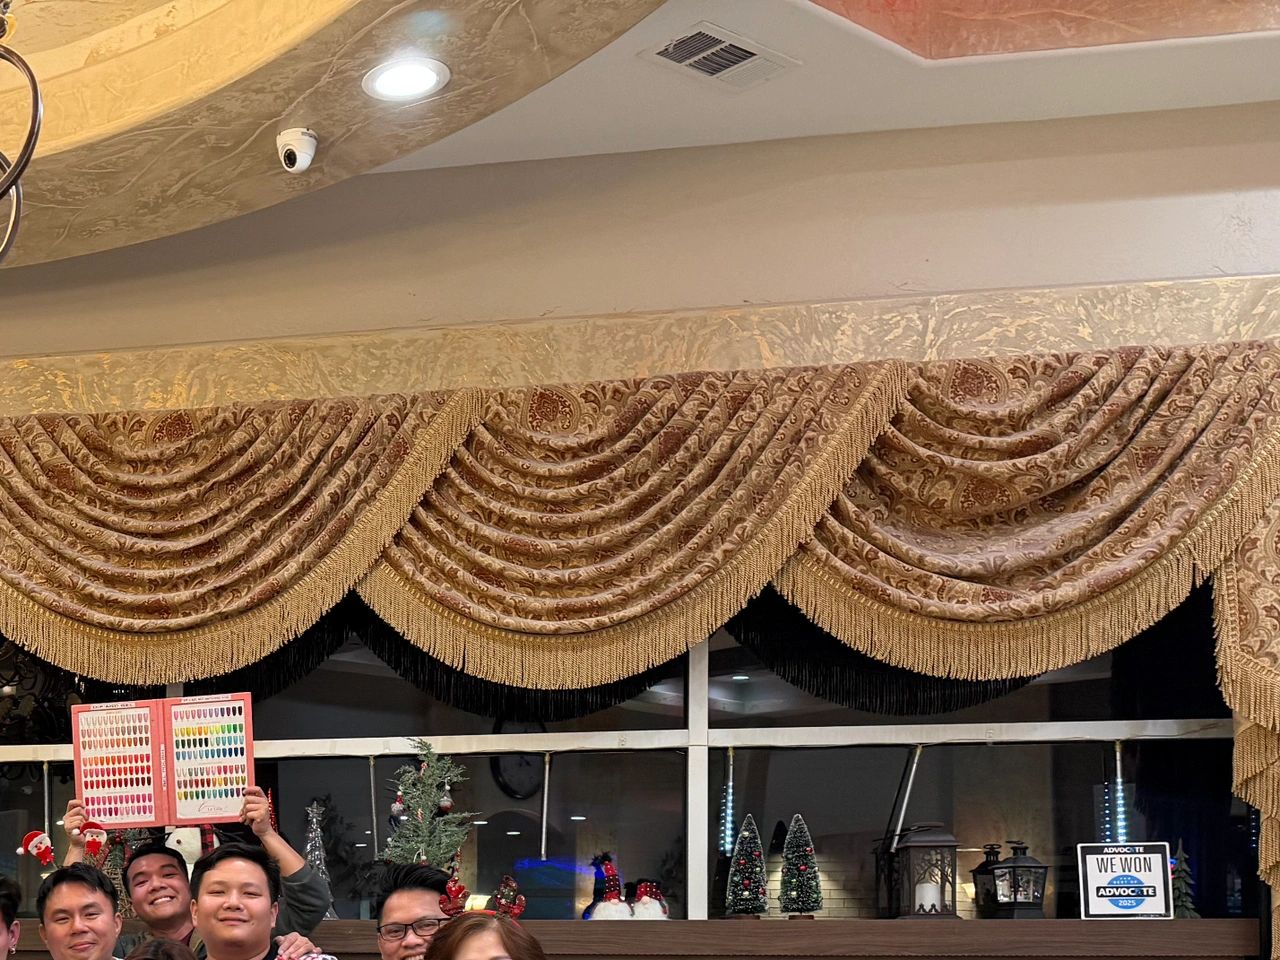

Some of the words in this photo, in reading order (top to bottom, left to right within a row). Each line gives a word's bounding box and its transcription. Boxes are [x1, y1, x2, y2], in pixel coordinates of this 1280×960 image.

[1096, 857, 1117, 873] WE
[1120, 856, 1152, 873] WON
[1118, 899, 1136, 907] 2025
